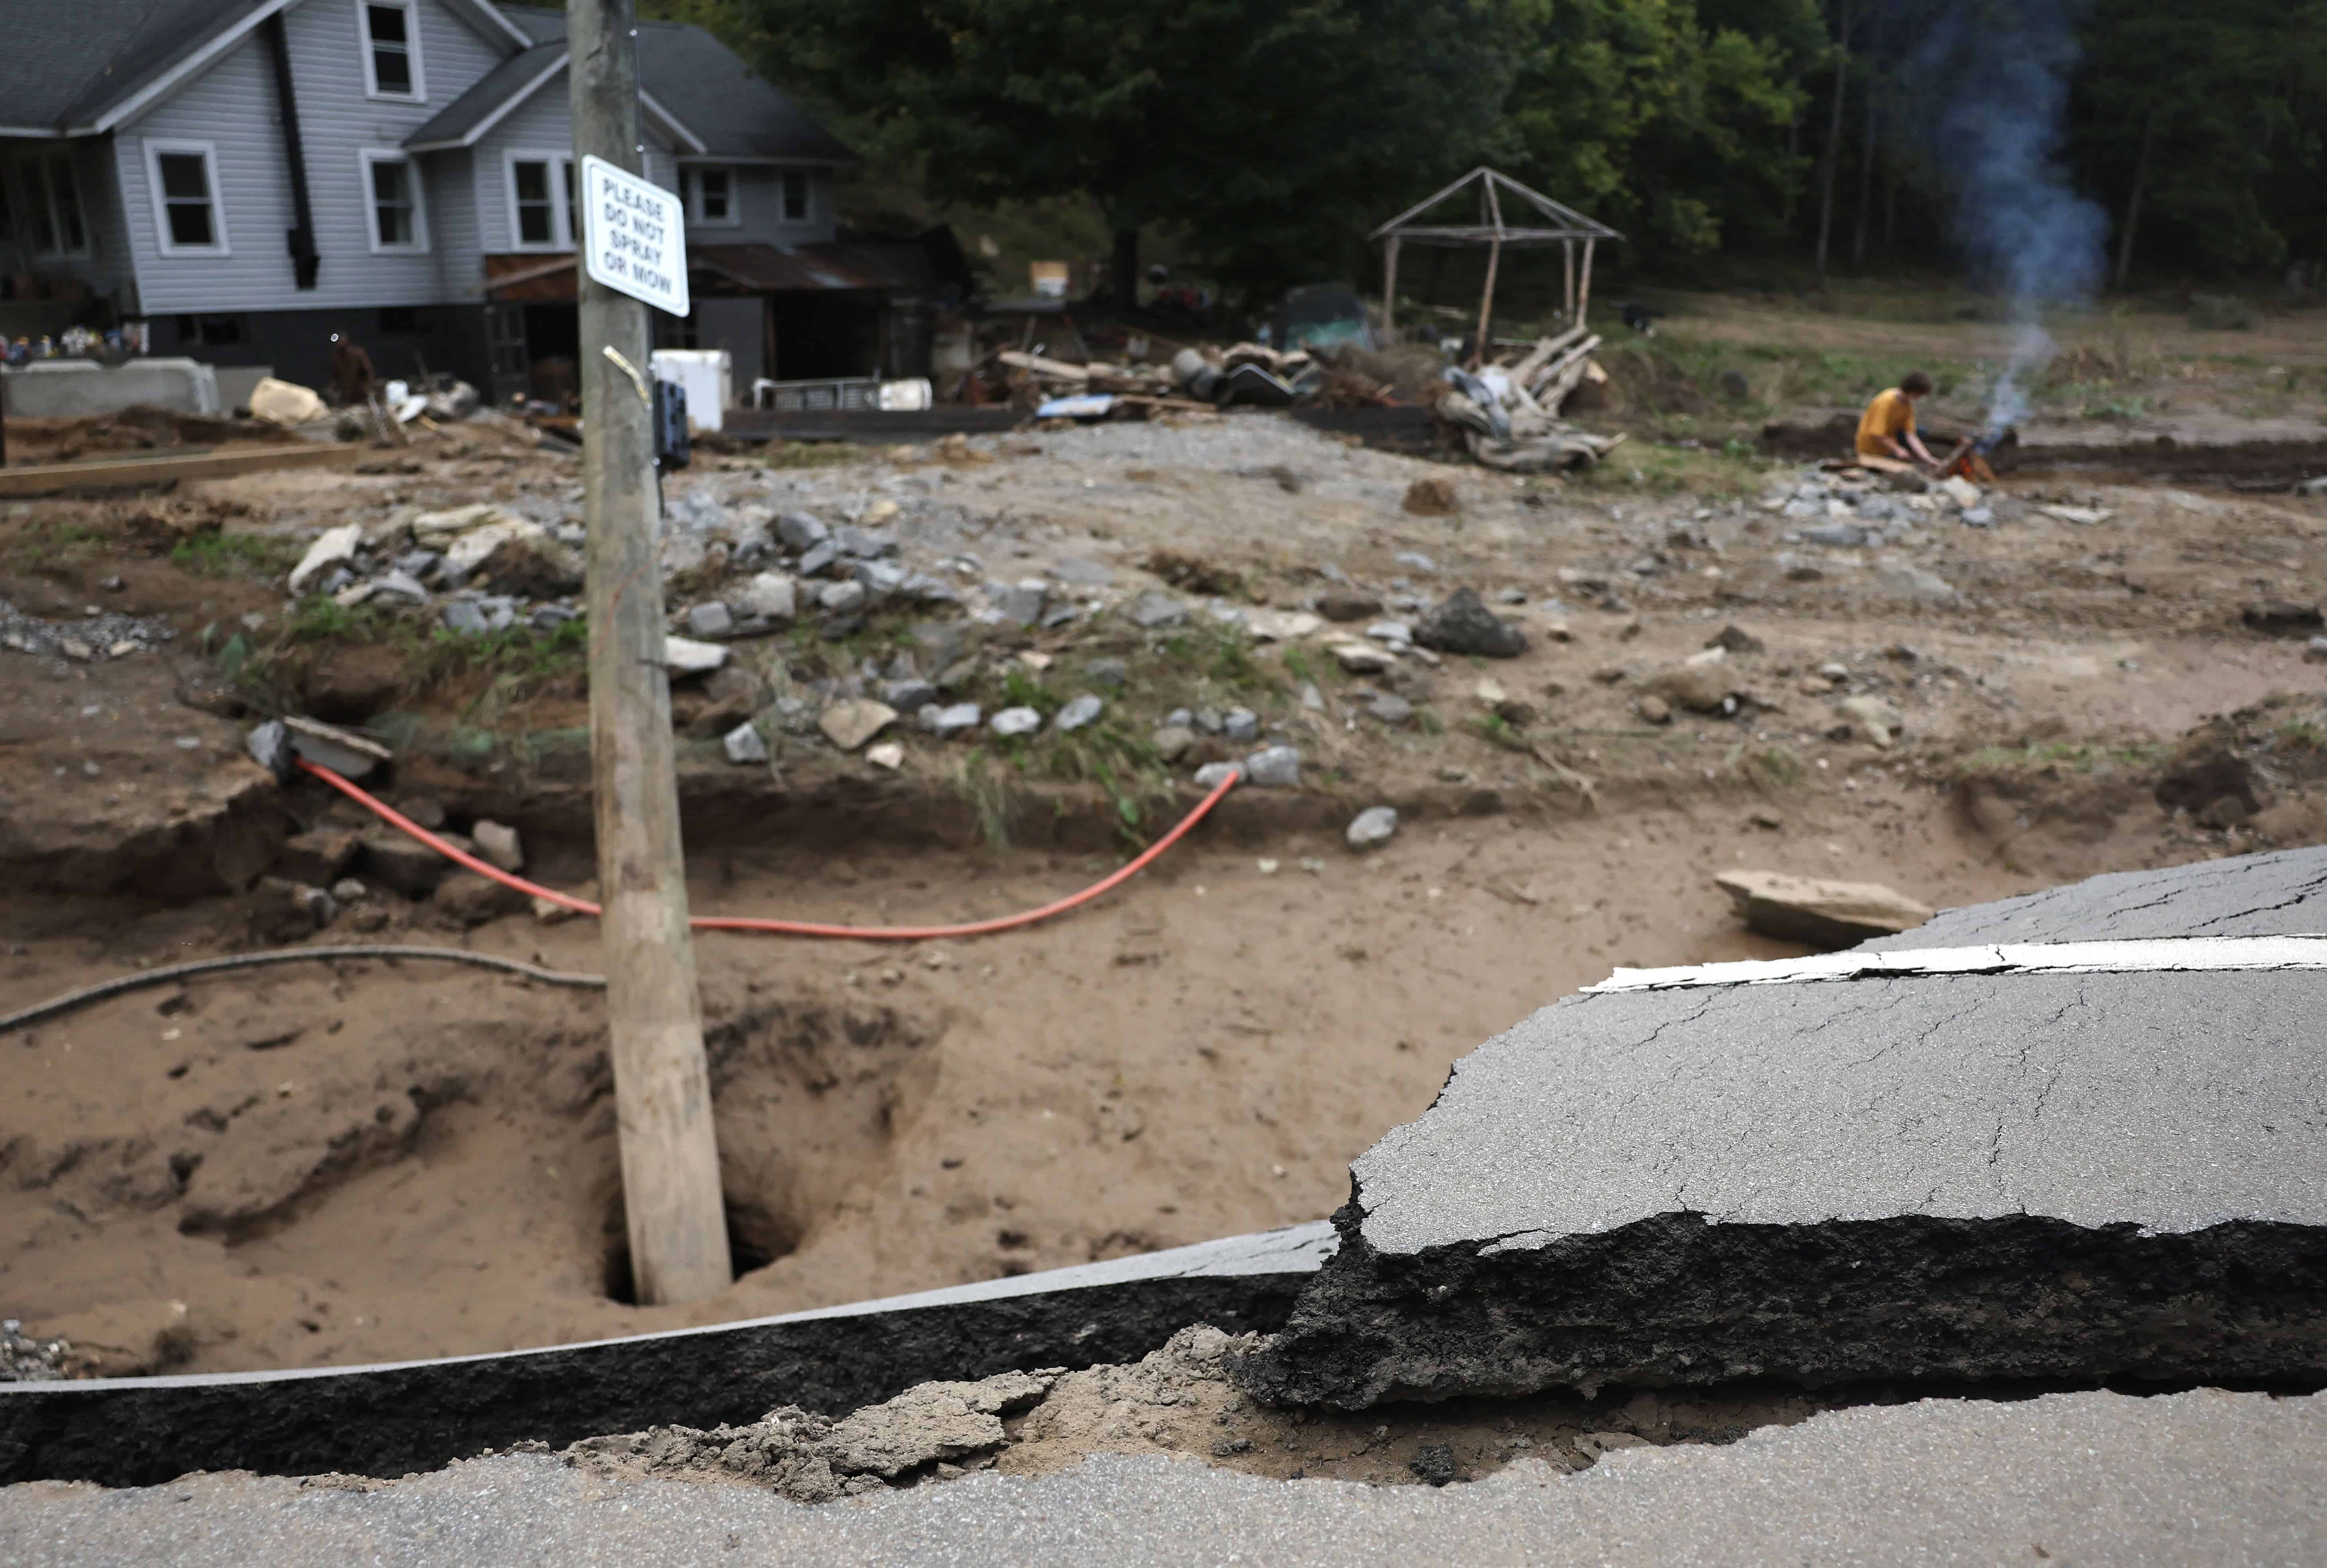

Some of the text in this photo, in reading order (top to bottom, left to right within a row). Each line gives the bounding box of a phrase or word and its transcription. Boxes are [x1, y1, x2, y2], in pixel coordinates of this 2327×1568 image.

[602, 177, 664, 222] PLEASE
[605, 202, 665, 243] DO NOT
[610, 228, 662, 265] SPRAY
[604, 251, 671, 294] OR MOW
